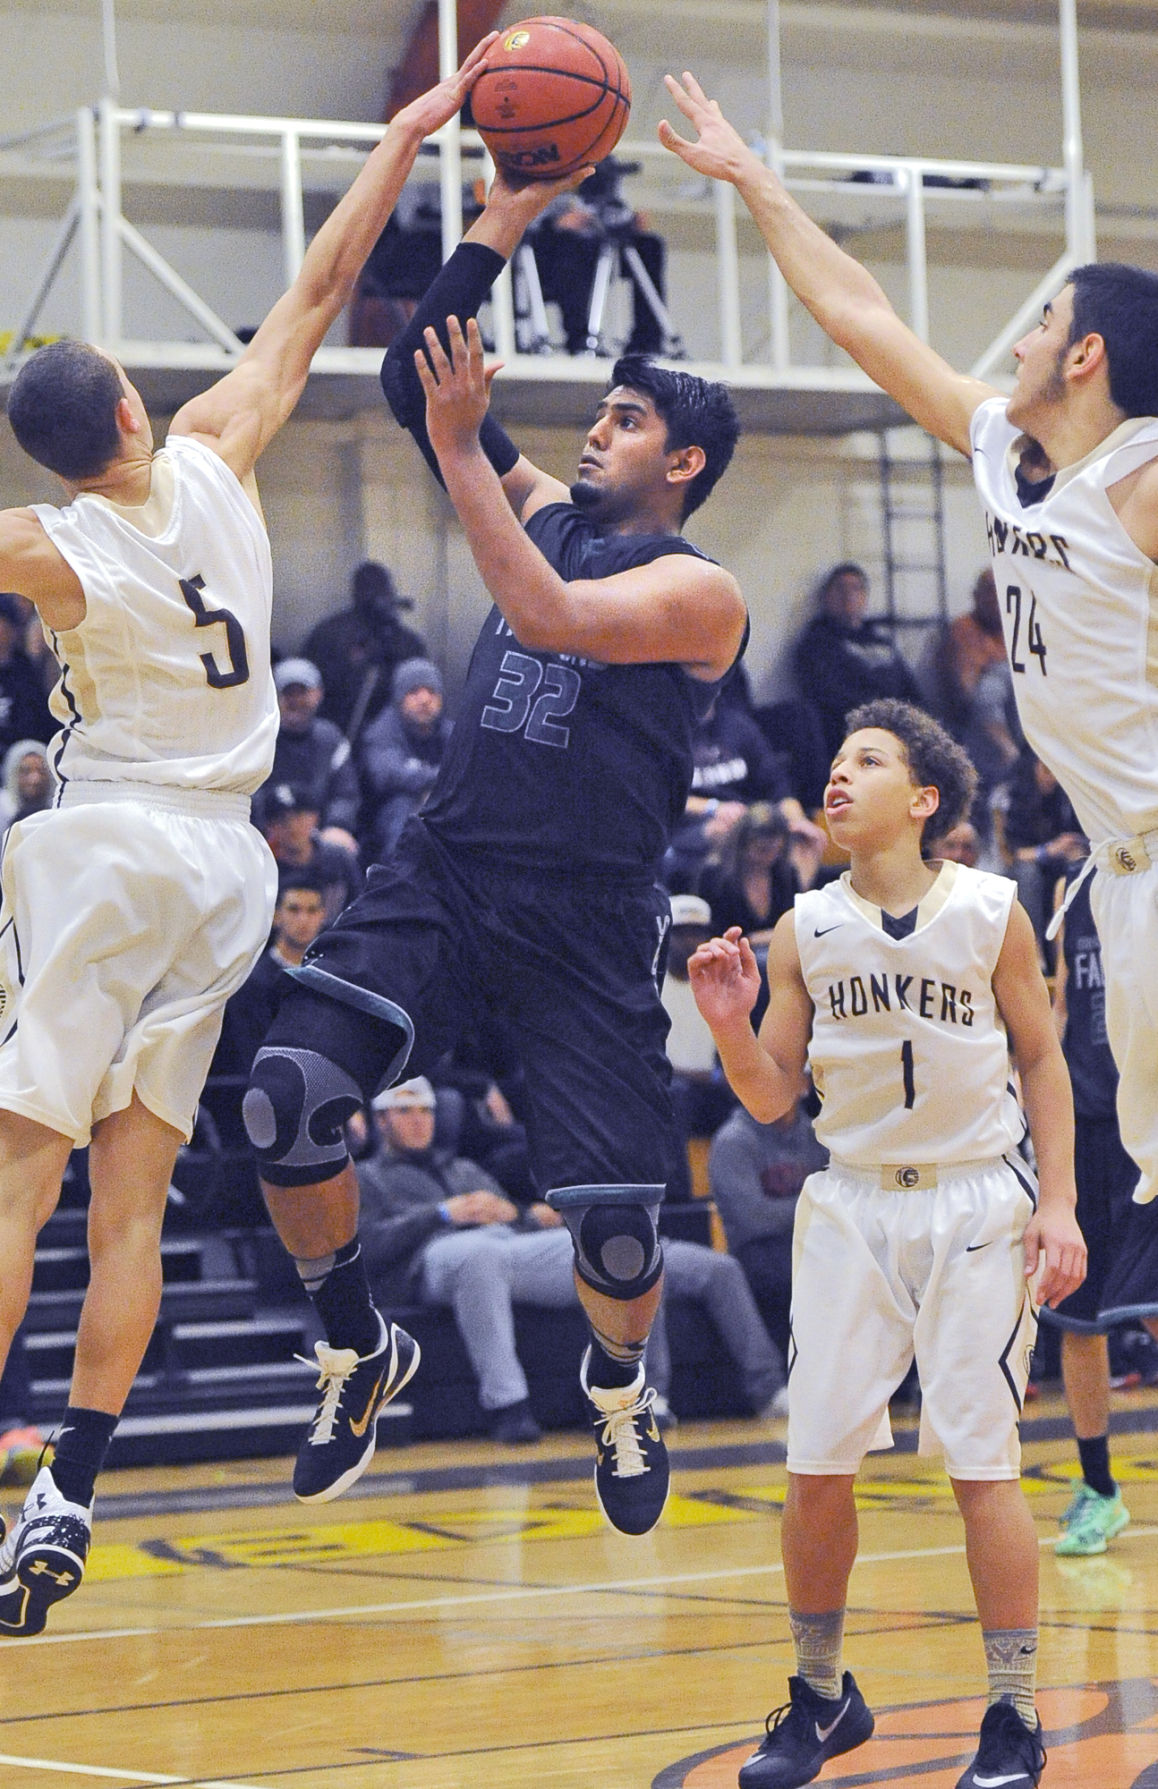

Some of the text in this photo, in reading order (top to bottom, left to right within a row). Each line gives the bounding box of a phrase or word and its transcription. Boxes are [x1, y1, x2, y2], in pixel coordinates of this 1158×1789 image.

[178, 573, 250, 689] 5
[1006, 585, 1047, 677] 24
[480, 650, 582, 749] 32
[828, 973, 975, 1027] HONKERS
[901, 1040, 916, 1110] 1
